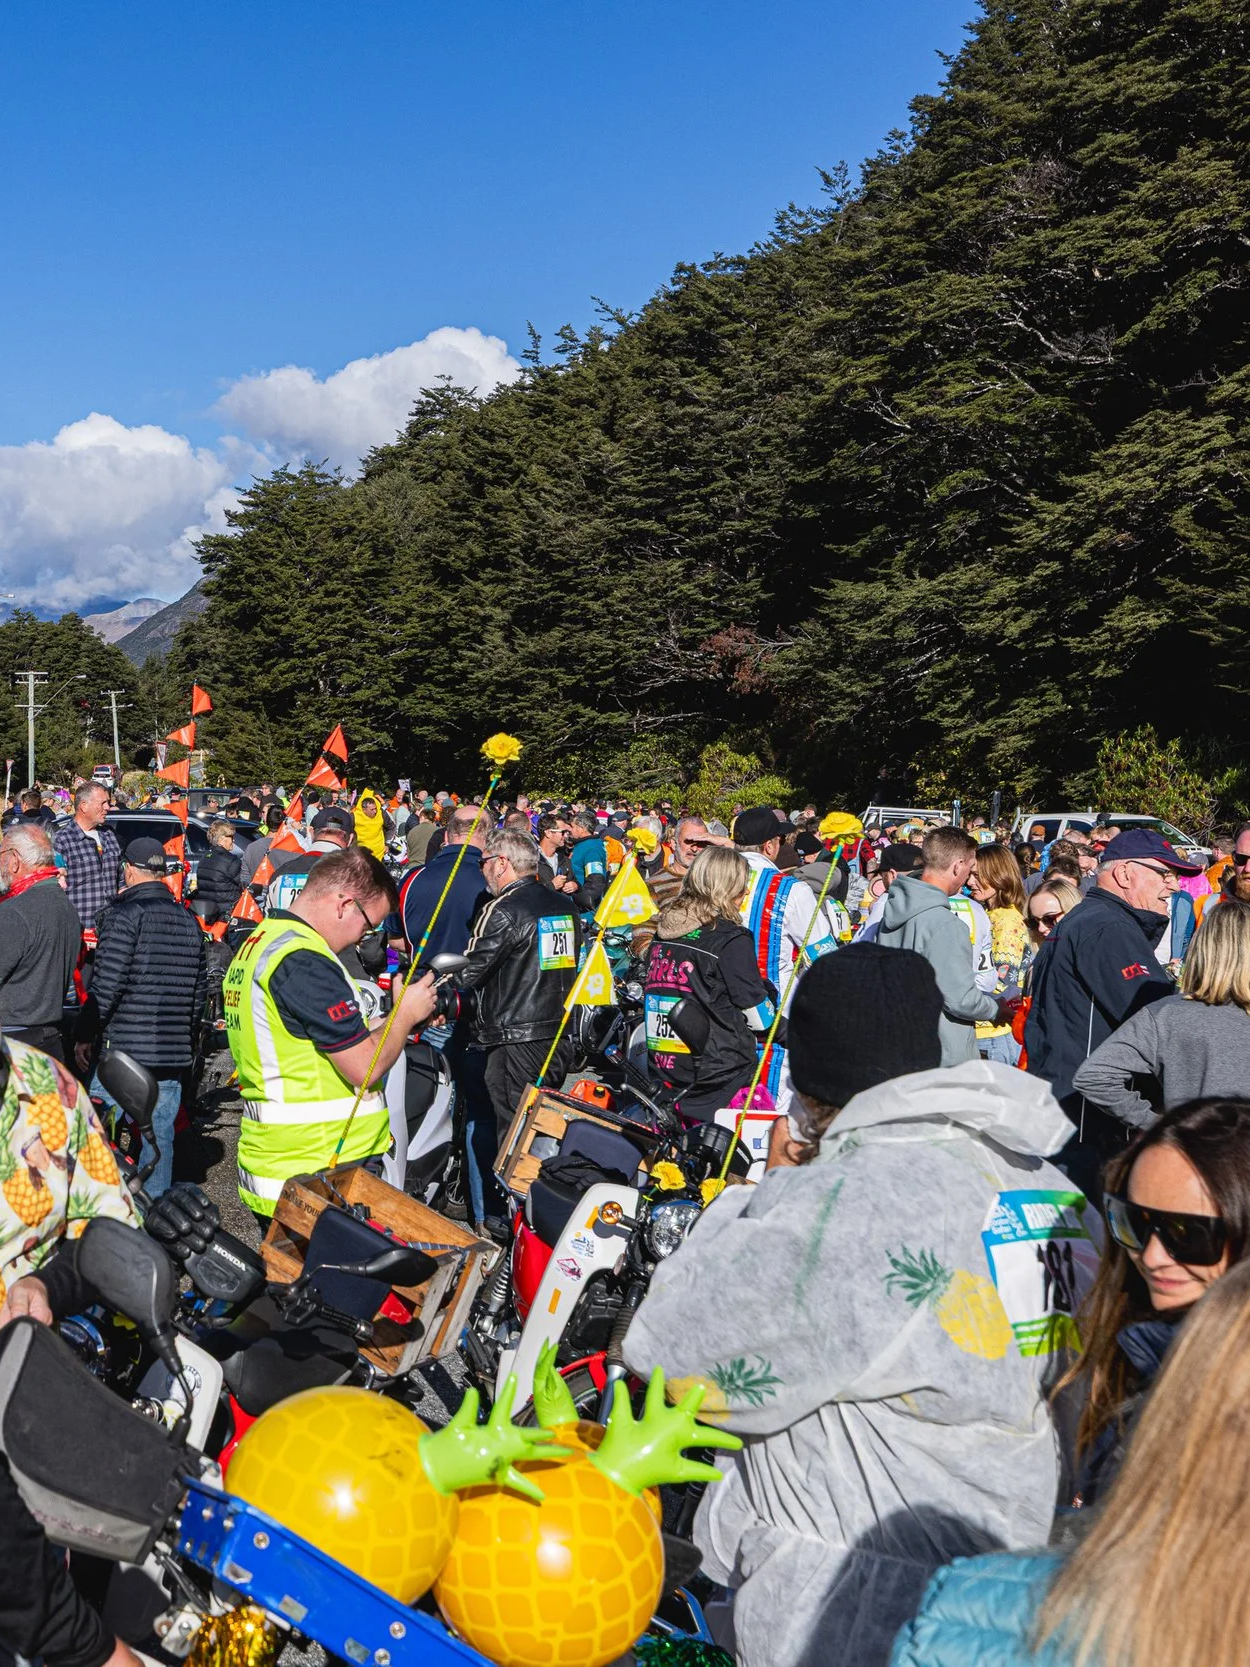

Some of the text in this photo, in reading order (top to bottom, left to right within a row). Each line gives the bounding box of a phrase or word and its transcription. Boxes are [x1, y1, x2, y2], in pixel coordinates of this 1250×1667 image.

[552, 932, 568, 956] 251
[225, 1012, 242, 1032] EAM
[212, 1243, 246, 1272] HONDA
